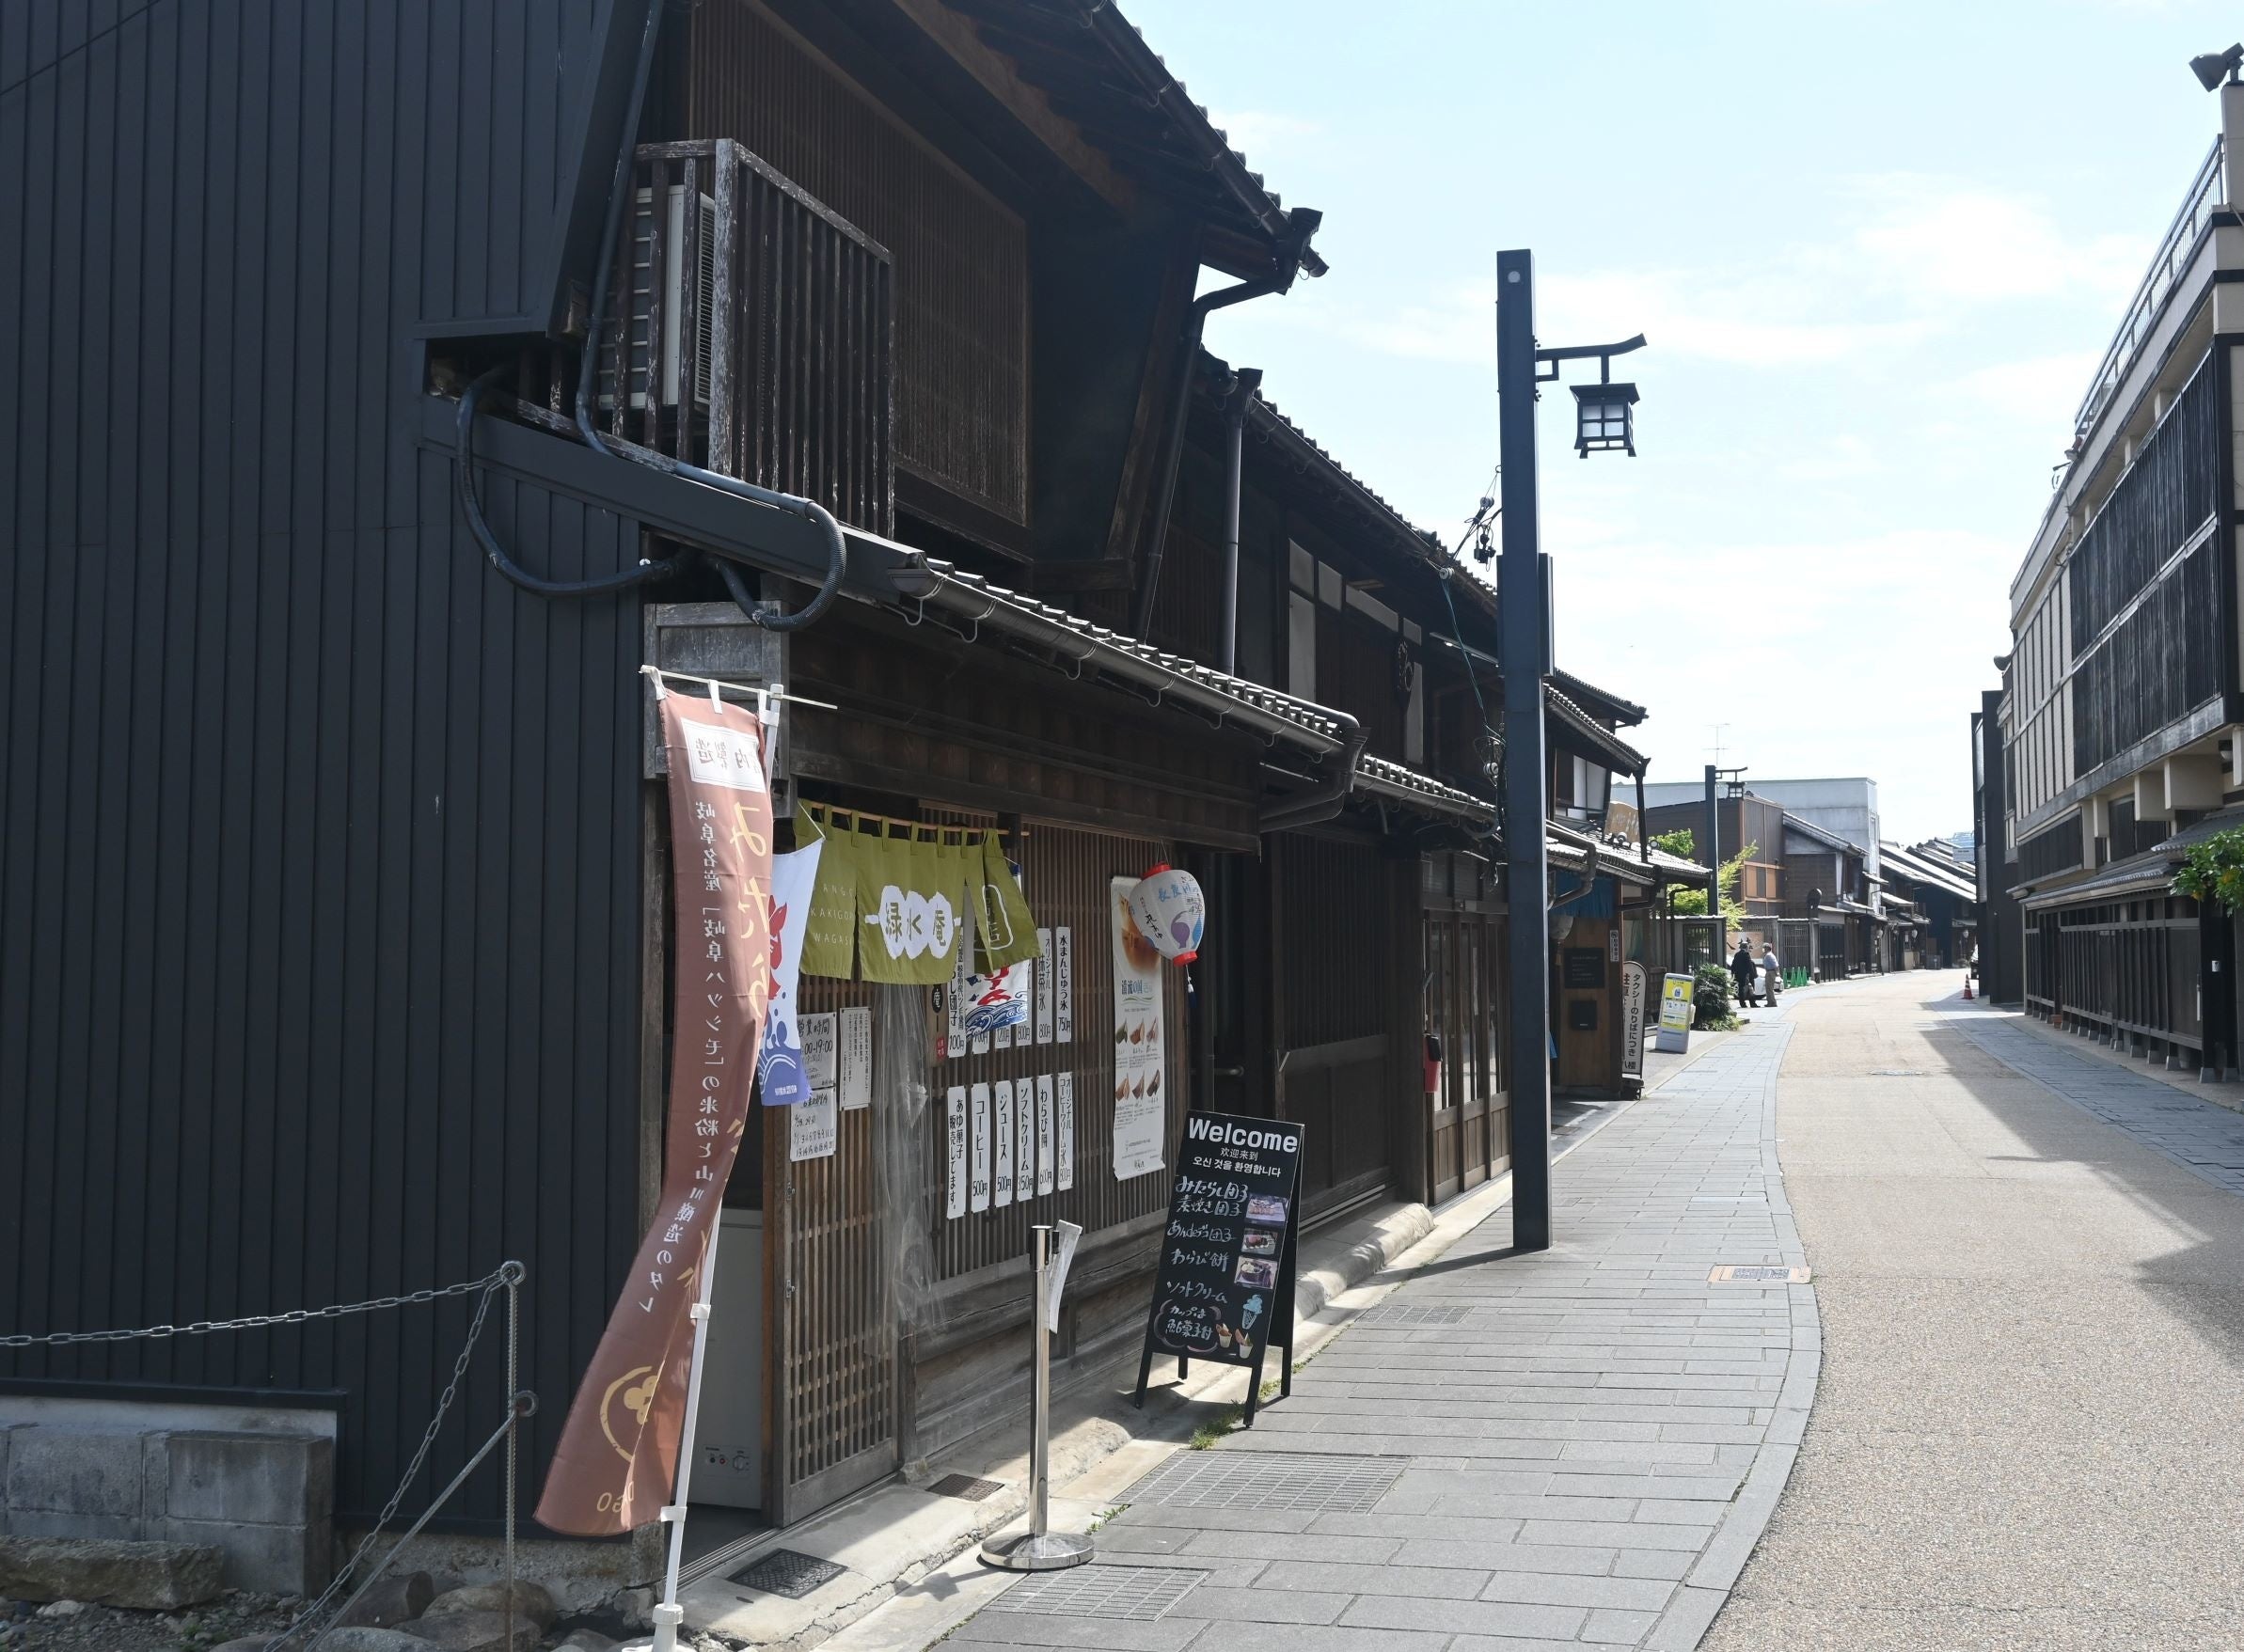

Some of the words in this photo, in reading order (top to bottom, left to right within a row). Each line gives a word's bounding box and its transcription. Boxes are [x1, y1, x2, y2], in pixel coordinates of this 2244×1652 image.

[1628, 974, 1641, 1057] タクシーのりばにつき
[975, 1100, 985, 1170] コーヒー
[1020, 1087, 1029, 1171] ソフトクリーム
[1189, 1117, 1298, 1153] Welcome
[1193, 1156, 1212, 1168] 오신
[1214, 1158, 1233, 1172] 것을
[1234, 1161, 1282, 1178] 환영합니다
[1220, 1147, 1258, 1161] 欢迎来到
[972, 1179, 988, 1197] 500円
[997, 1175, 1012, 1192] 500円
[1176, 1175, 1249, 1203] みたらし団子
